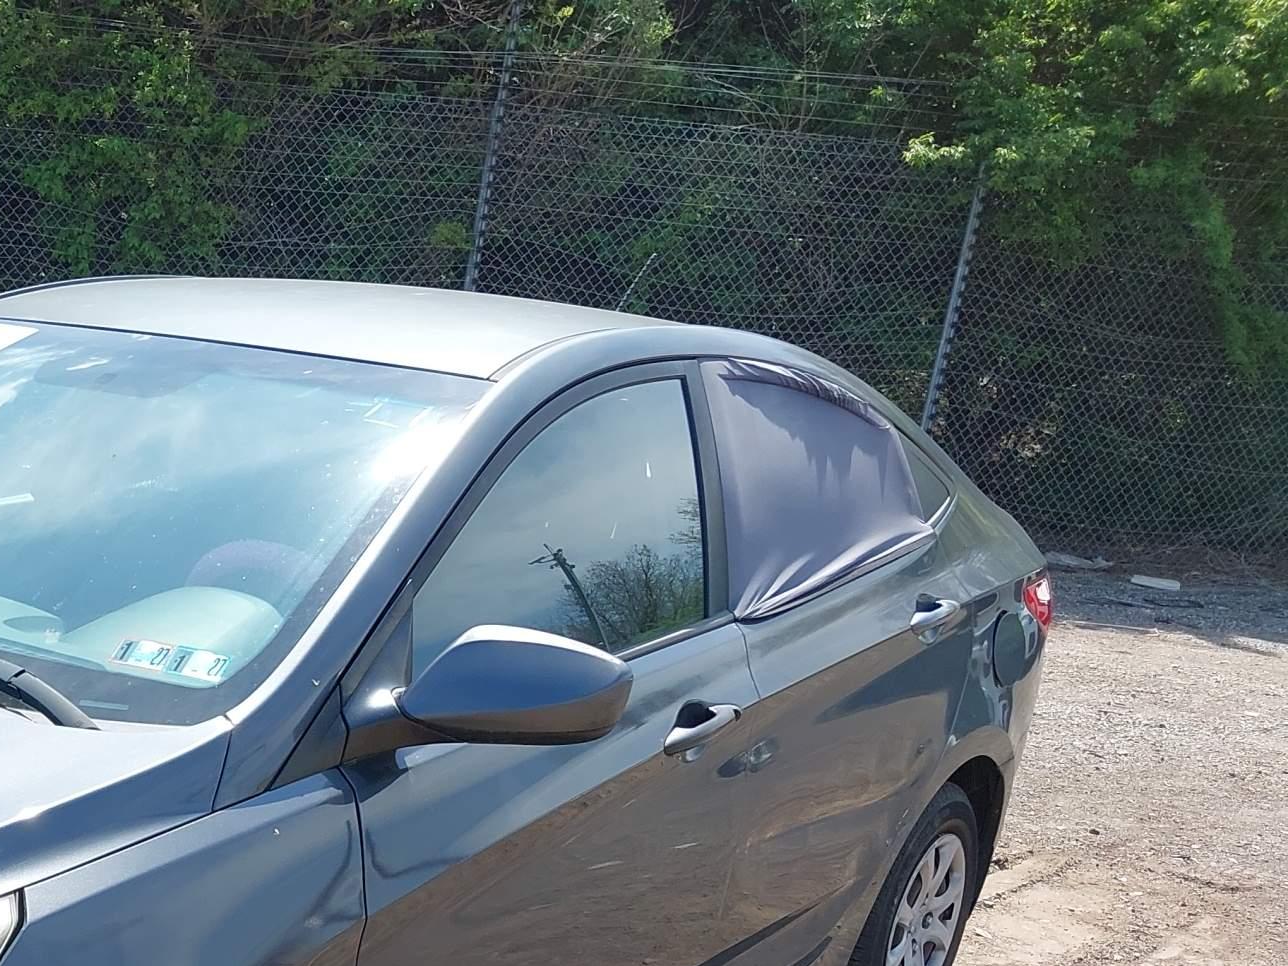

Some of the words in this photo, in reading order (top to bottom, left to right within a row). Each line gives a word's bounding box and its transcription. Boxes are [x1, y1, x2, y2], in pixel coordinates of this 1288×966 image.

[120, 641, 133, 660] 1
[150, 647, 171, 667] 27
[174, 655, 186, 672] 1
[207, 657, 227, 677] 27
